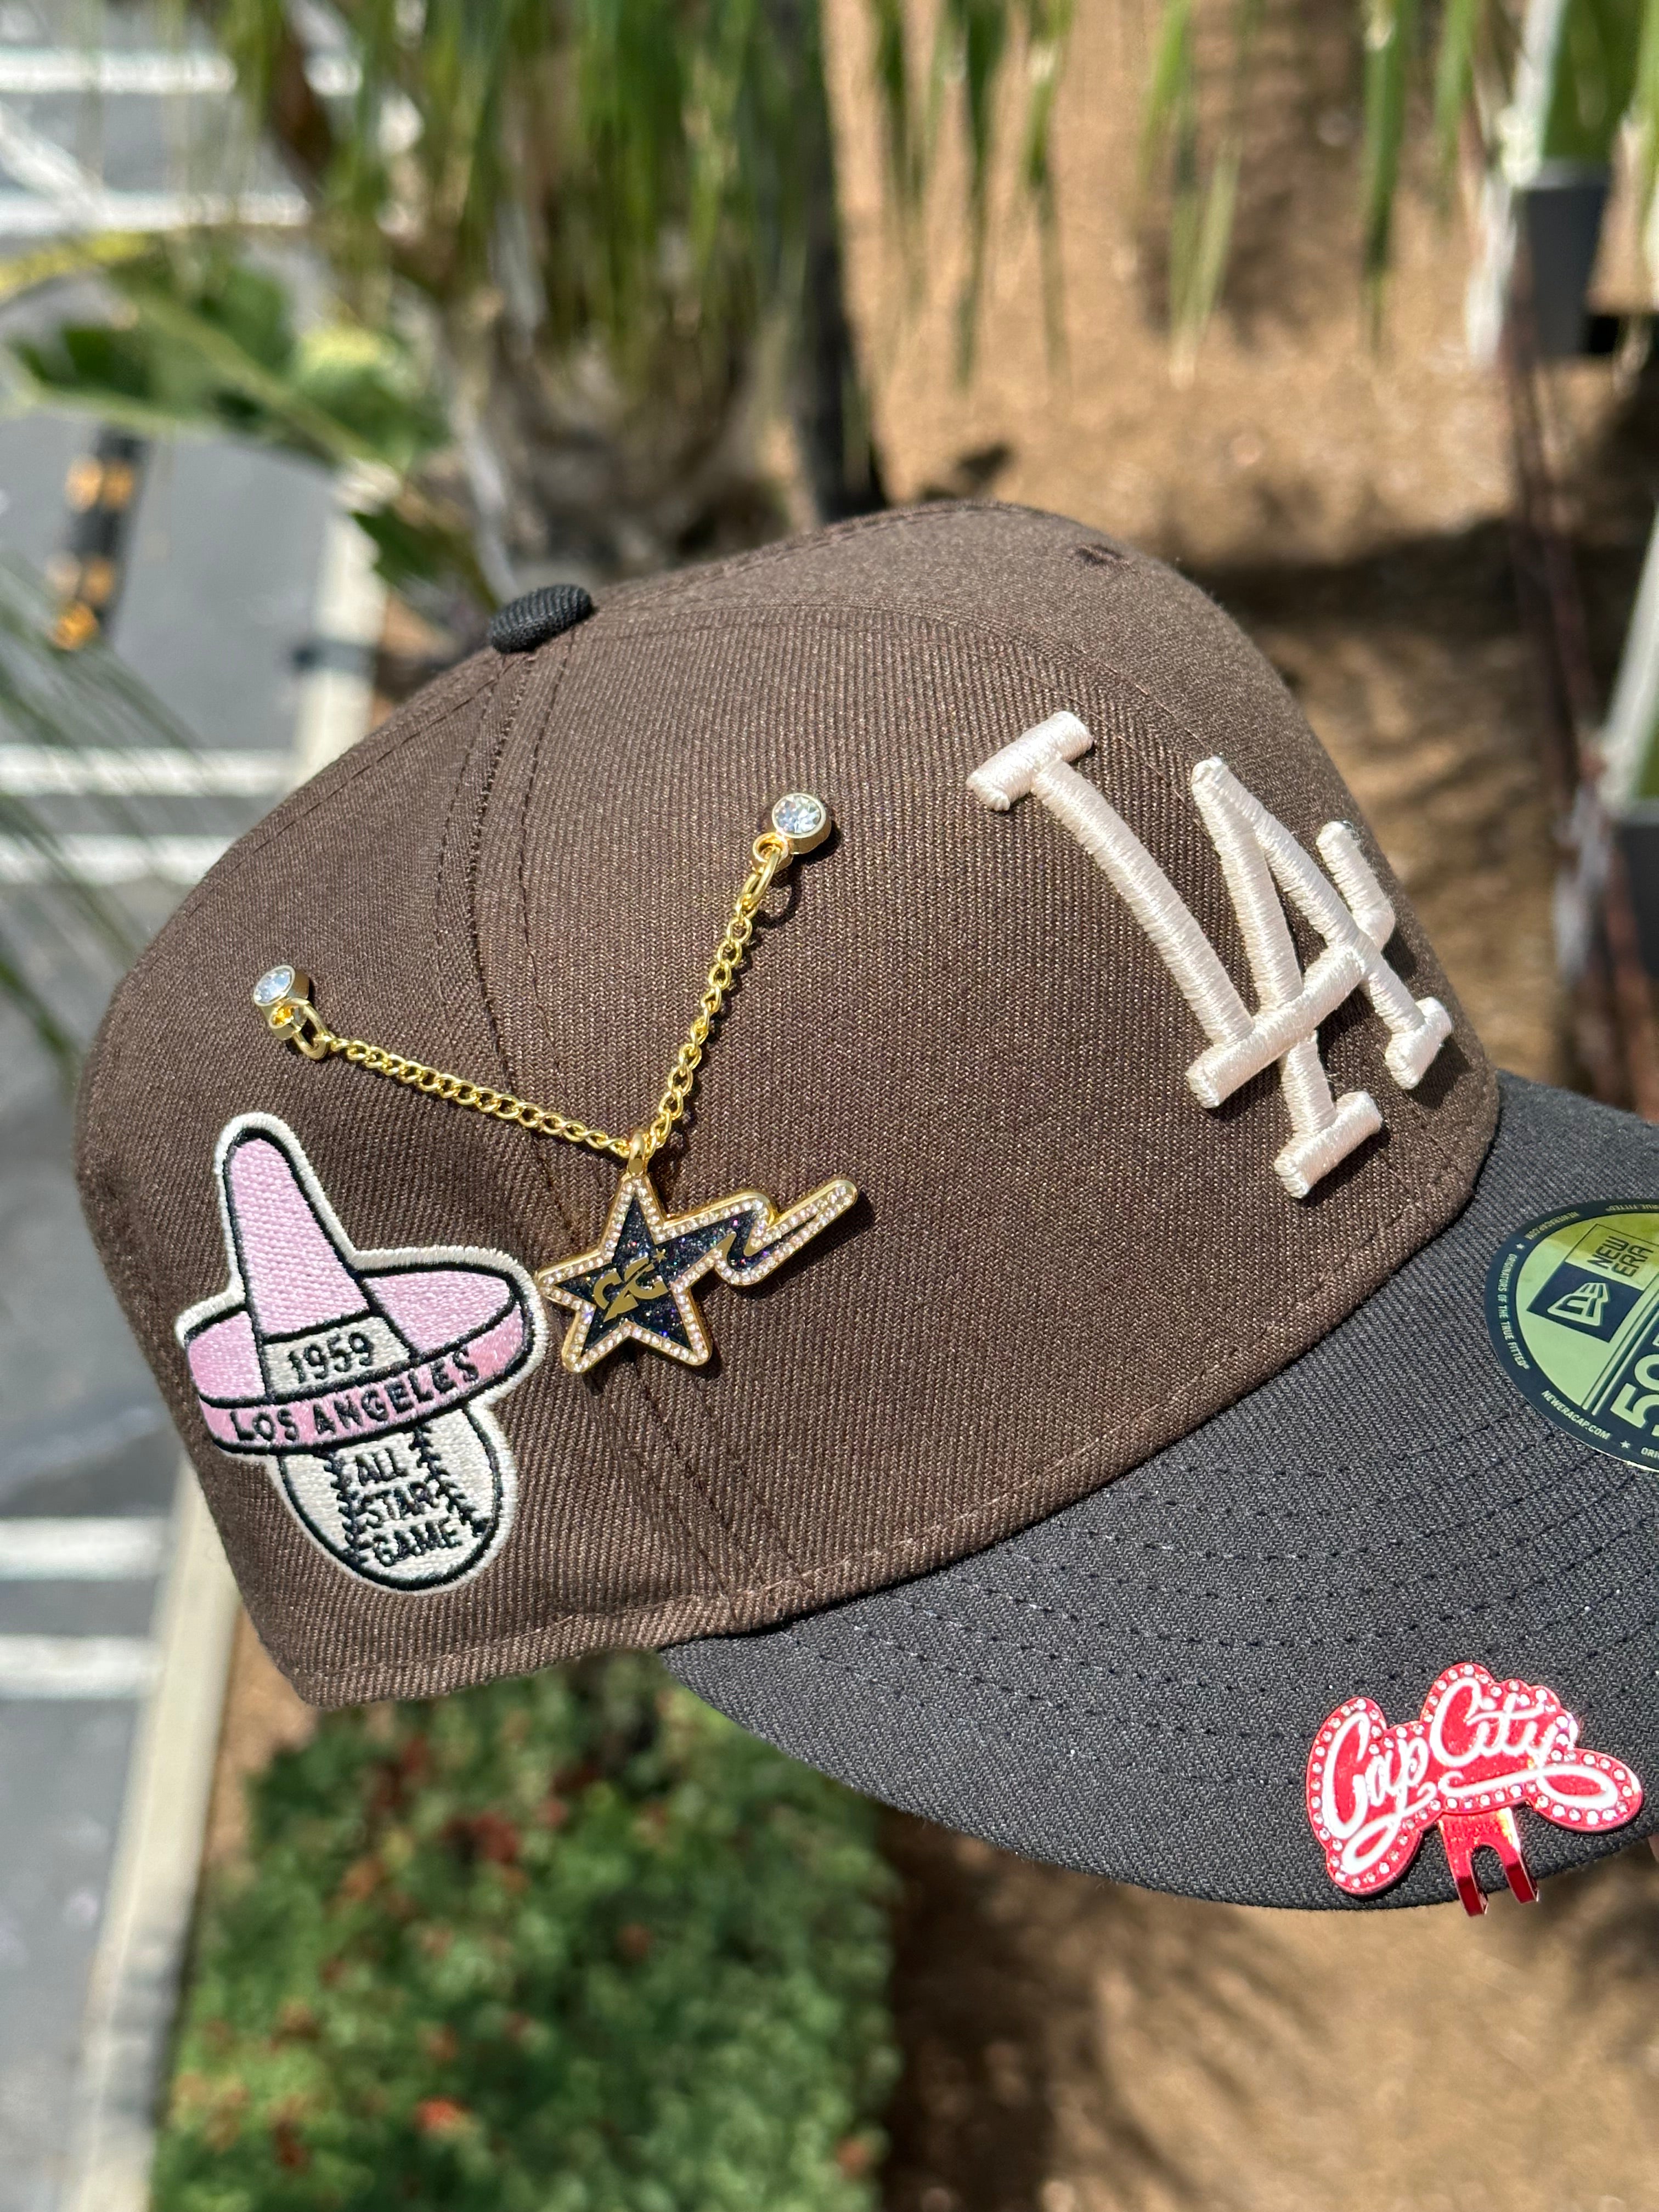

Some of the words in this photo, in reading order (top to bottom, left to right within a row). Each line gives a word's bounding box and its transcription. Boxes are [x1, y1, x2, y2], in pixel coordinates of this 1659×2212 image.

[966, 710, 1452, 1198] LA
[1497, 1253, 1517, 1292] ORIGINATORS
[1587, 1235, 1629, 1269] NEW
[1611, 1245, 1654, 1277] ERA
[1497, 1294, 1507, 1303] OF
[1497, 1305, 1509, 1319] THE
[1500, 1321, 1515, 1340] TRUE
[288, 1332, 375, 1383] 1959
[230, 1409, 300, 1441] LOS
[313, 1346, 480, 1434] ANGELES
[1541, 1390, 1611, 1440] NEWERACAP.COM
[356, 1448, 408, 1481] ALL
[362, 1480, 440, 1528] STAR
[373, 1516, 462, 1566] GAME
[1323, 1712, 1437, 1874] Cap
[1430, 1676, 1618, 1810] City
